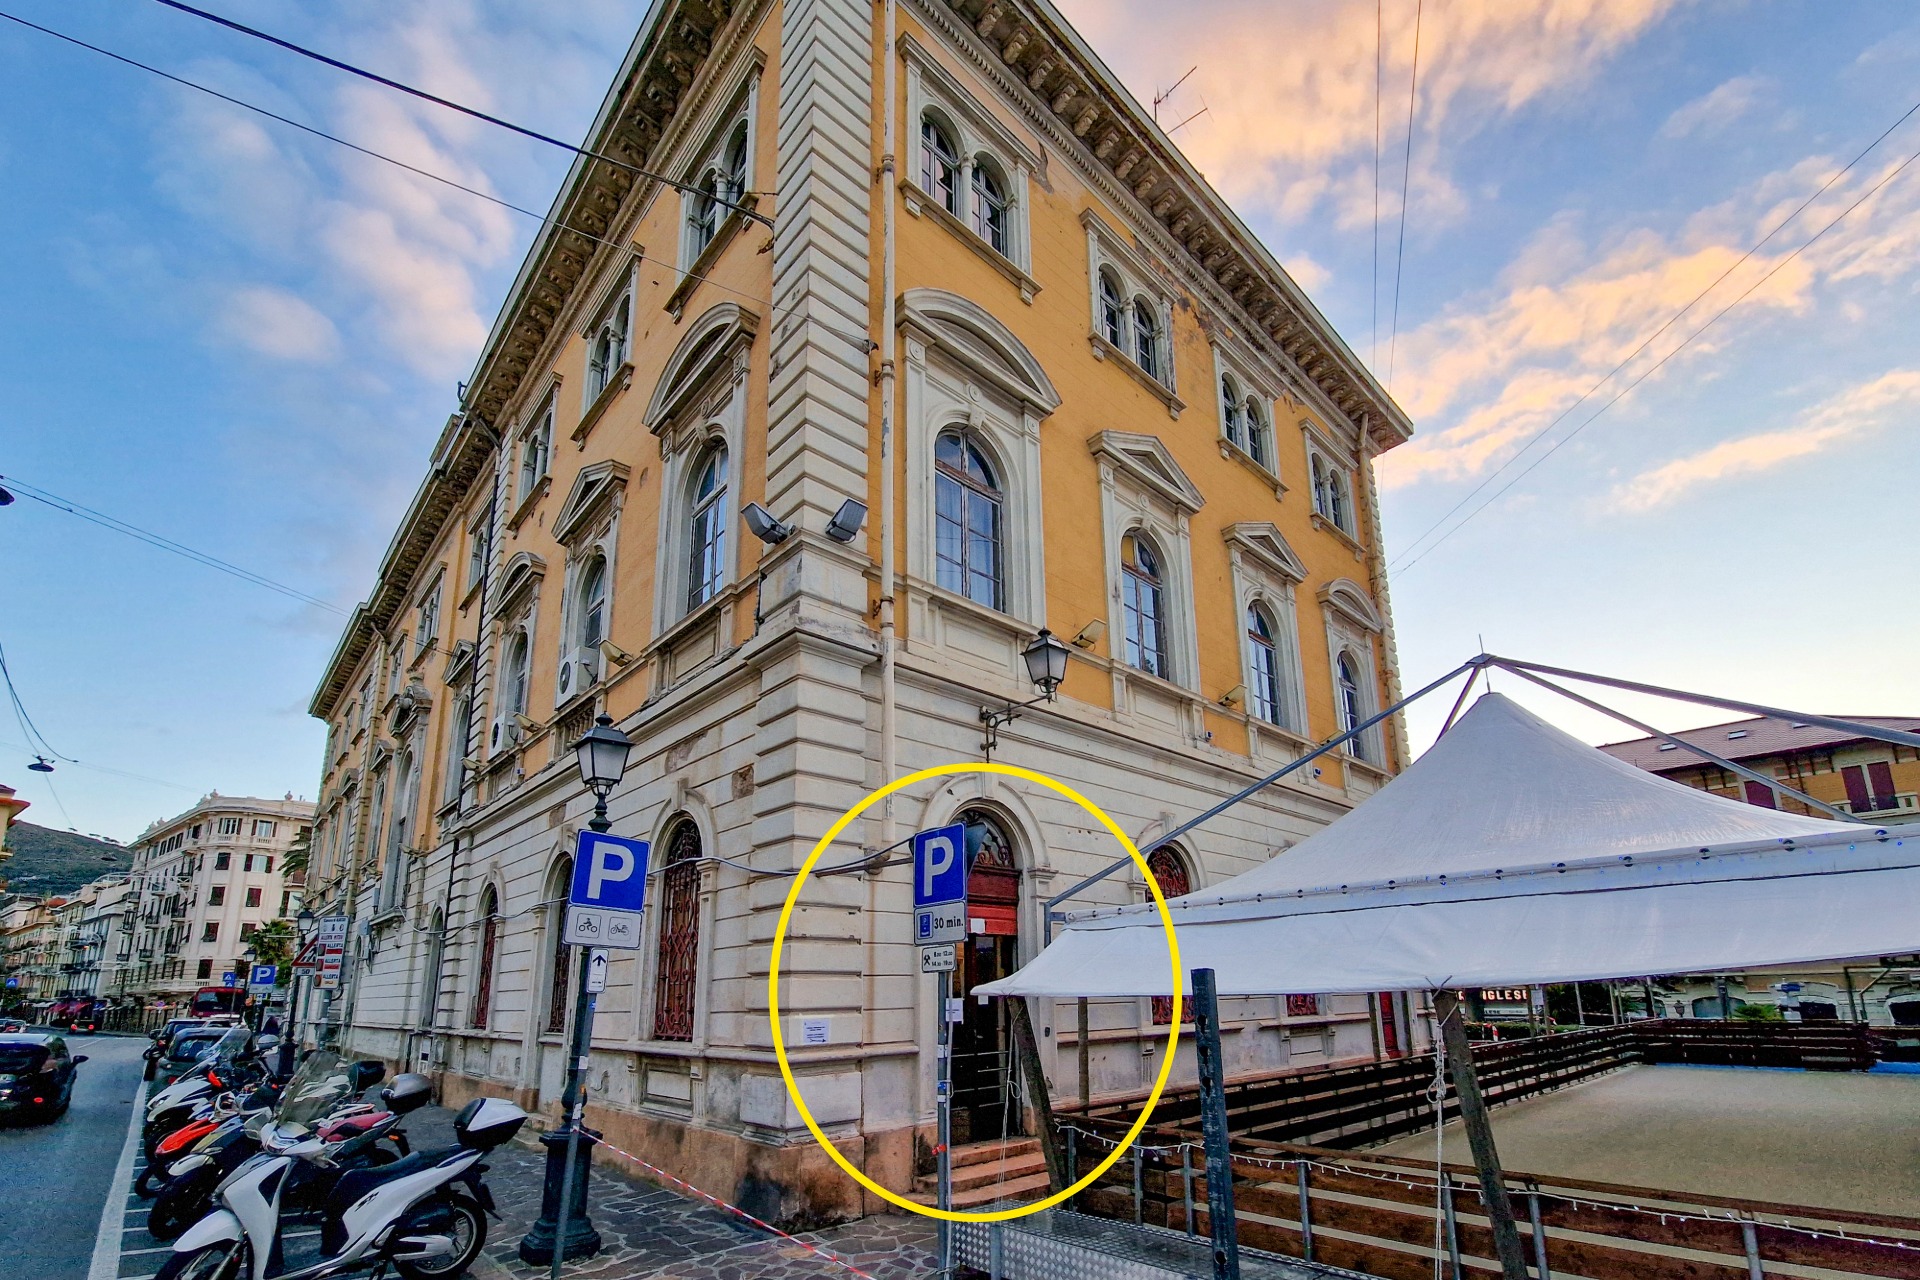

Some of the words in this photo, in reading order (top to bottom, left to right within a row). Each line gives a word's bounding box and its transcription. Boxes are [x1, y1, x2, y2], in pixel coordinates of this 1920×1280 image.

[587, 841, 634, 899] P
[924, 836, 954, 897] P
[934, 917, 944, 929] 30
[946, 915, 963, 928] min.
[256, 968, 270, 982] P
